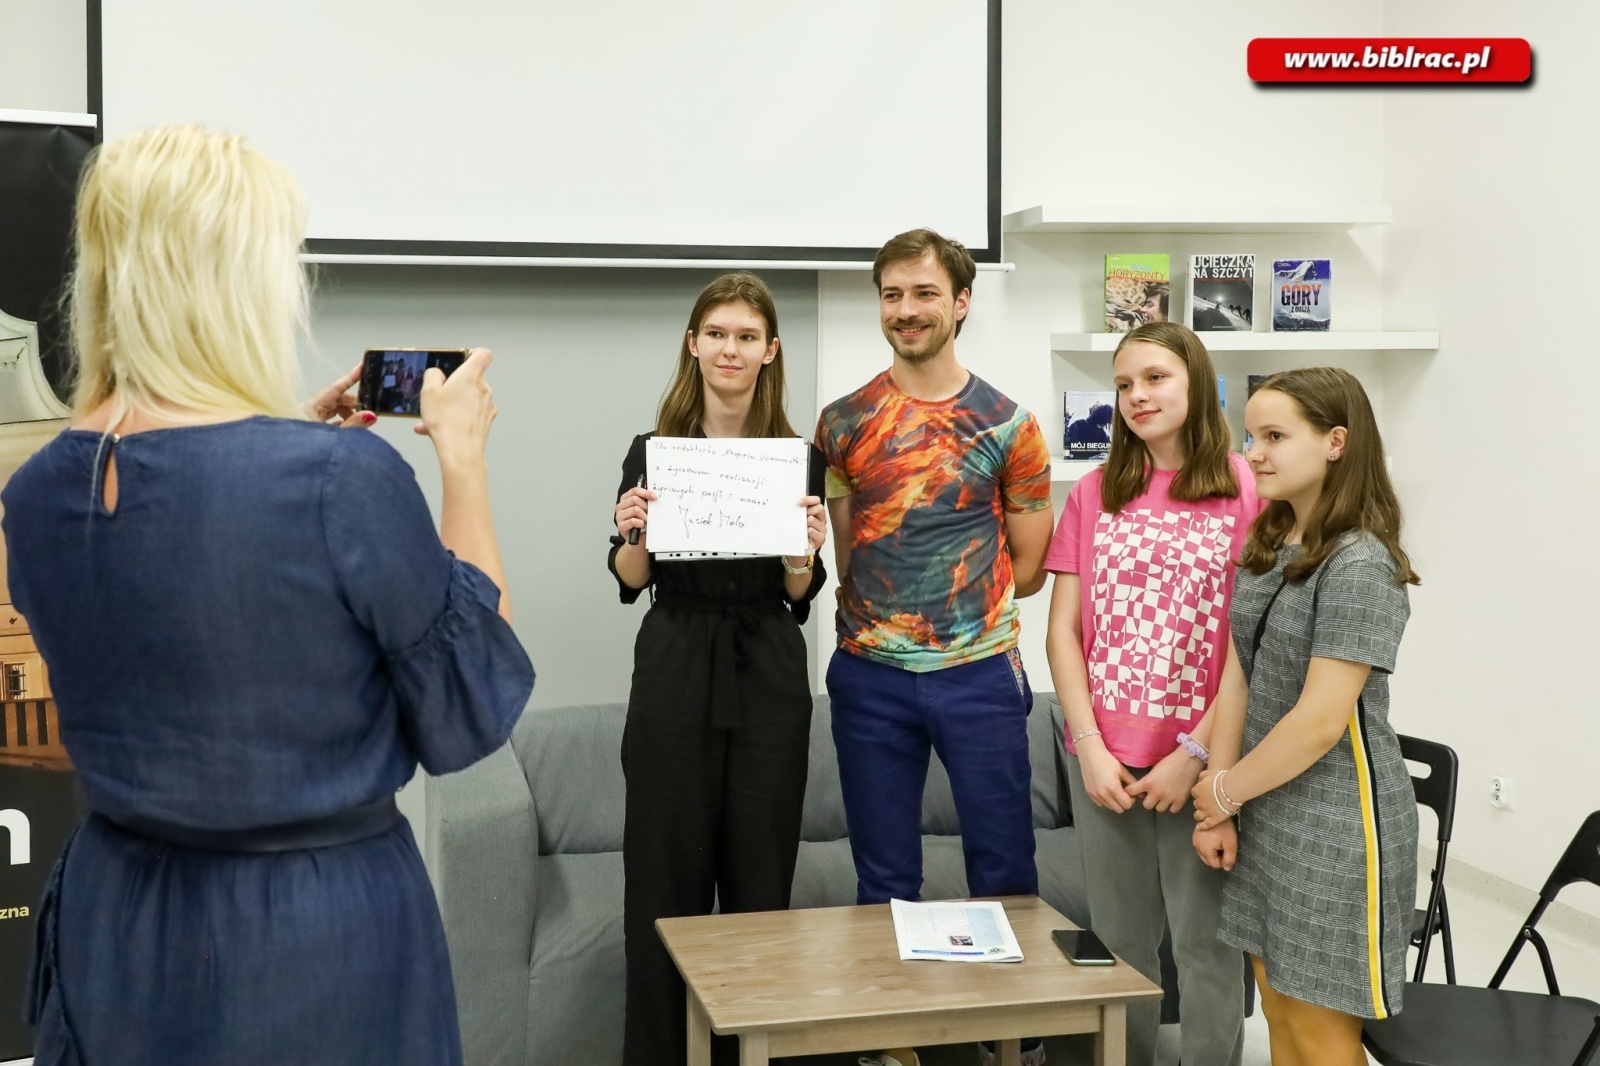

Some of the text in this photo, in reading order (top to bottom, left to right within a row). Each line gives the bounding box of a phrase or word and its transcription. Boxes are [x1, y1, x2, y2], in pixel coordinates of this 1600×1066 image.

[1194, 255, 1254, 268] UCIECZKA
[1108, 269, 1166, 280] HORYZONTY
[1194, 267, 1254, 278] NA SZCZYT
[1071, 441, 1086, 449] MÓJ
